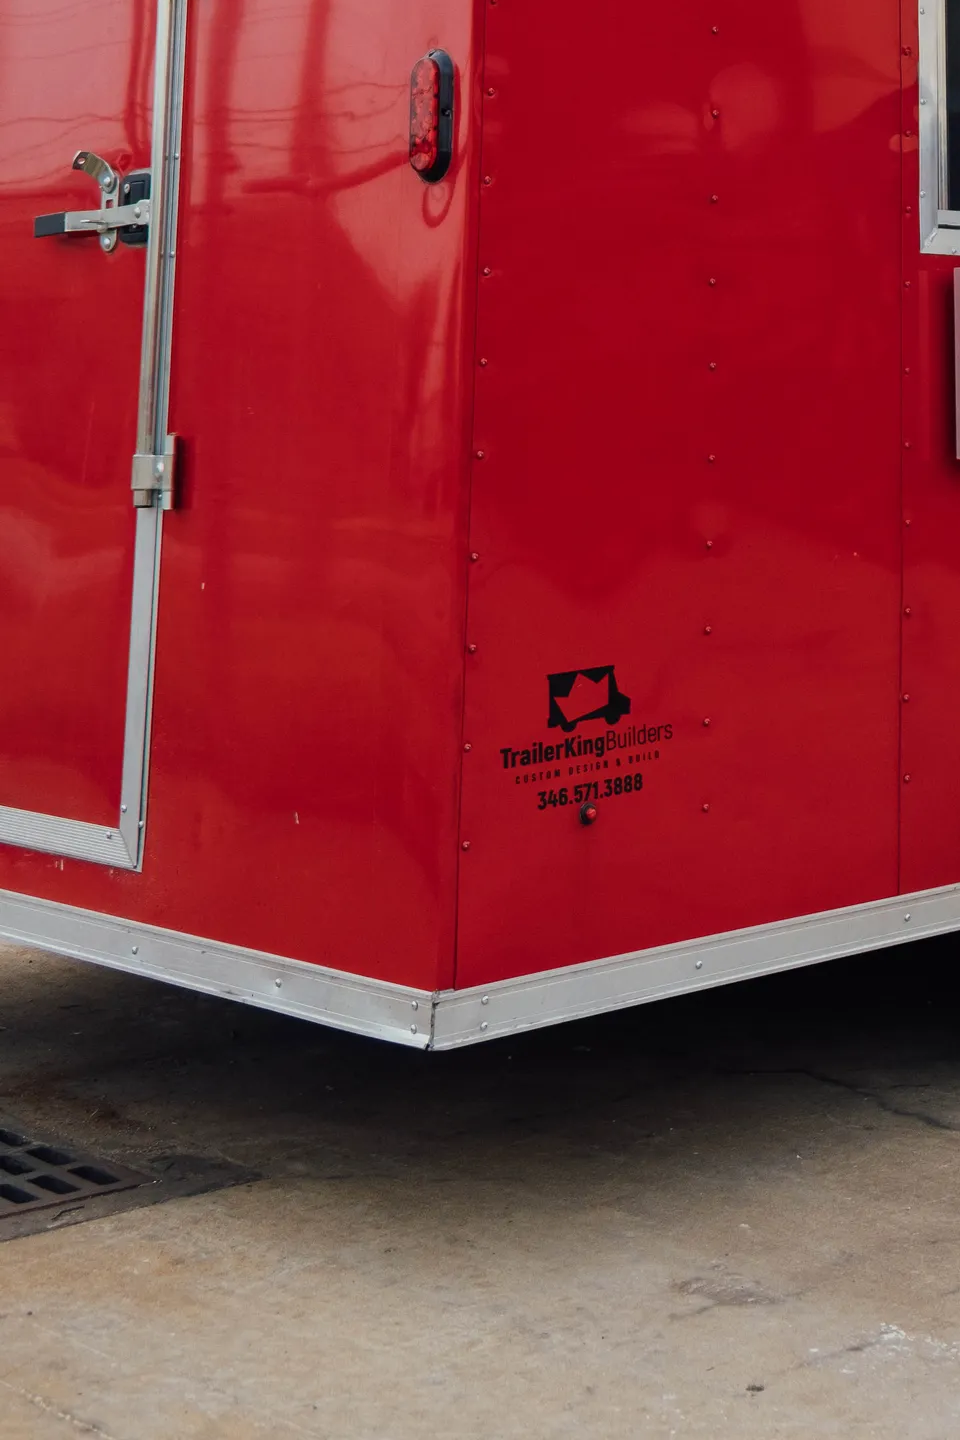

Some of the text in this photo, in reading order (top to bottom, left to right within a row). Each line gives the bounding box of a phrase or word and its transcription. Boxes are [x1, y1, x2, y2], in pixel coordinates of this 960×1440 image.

[500, 723, 674, 769] TrailerKingBuilders
[515, 769, 561, 785] CUSTOM
[568, 760, 609, 776] DESIGN
[628, 750, 660, 764] BUILD
[537, 773, 643, 810] 346.571.3888
